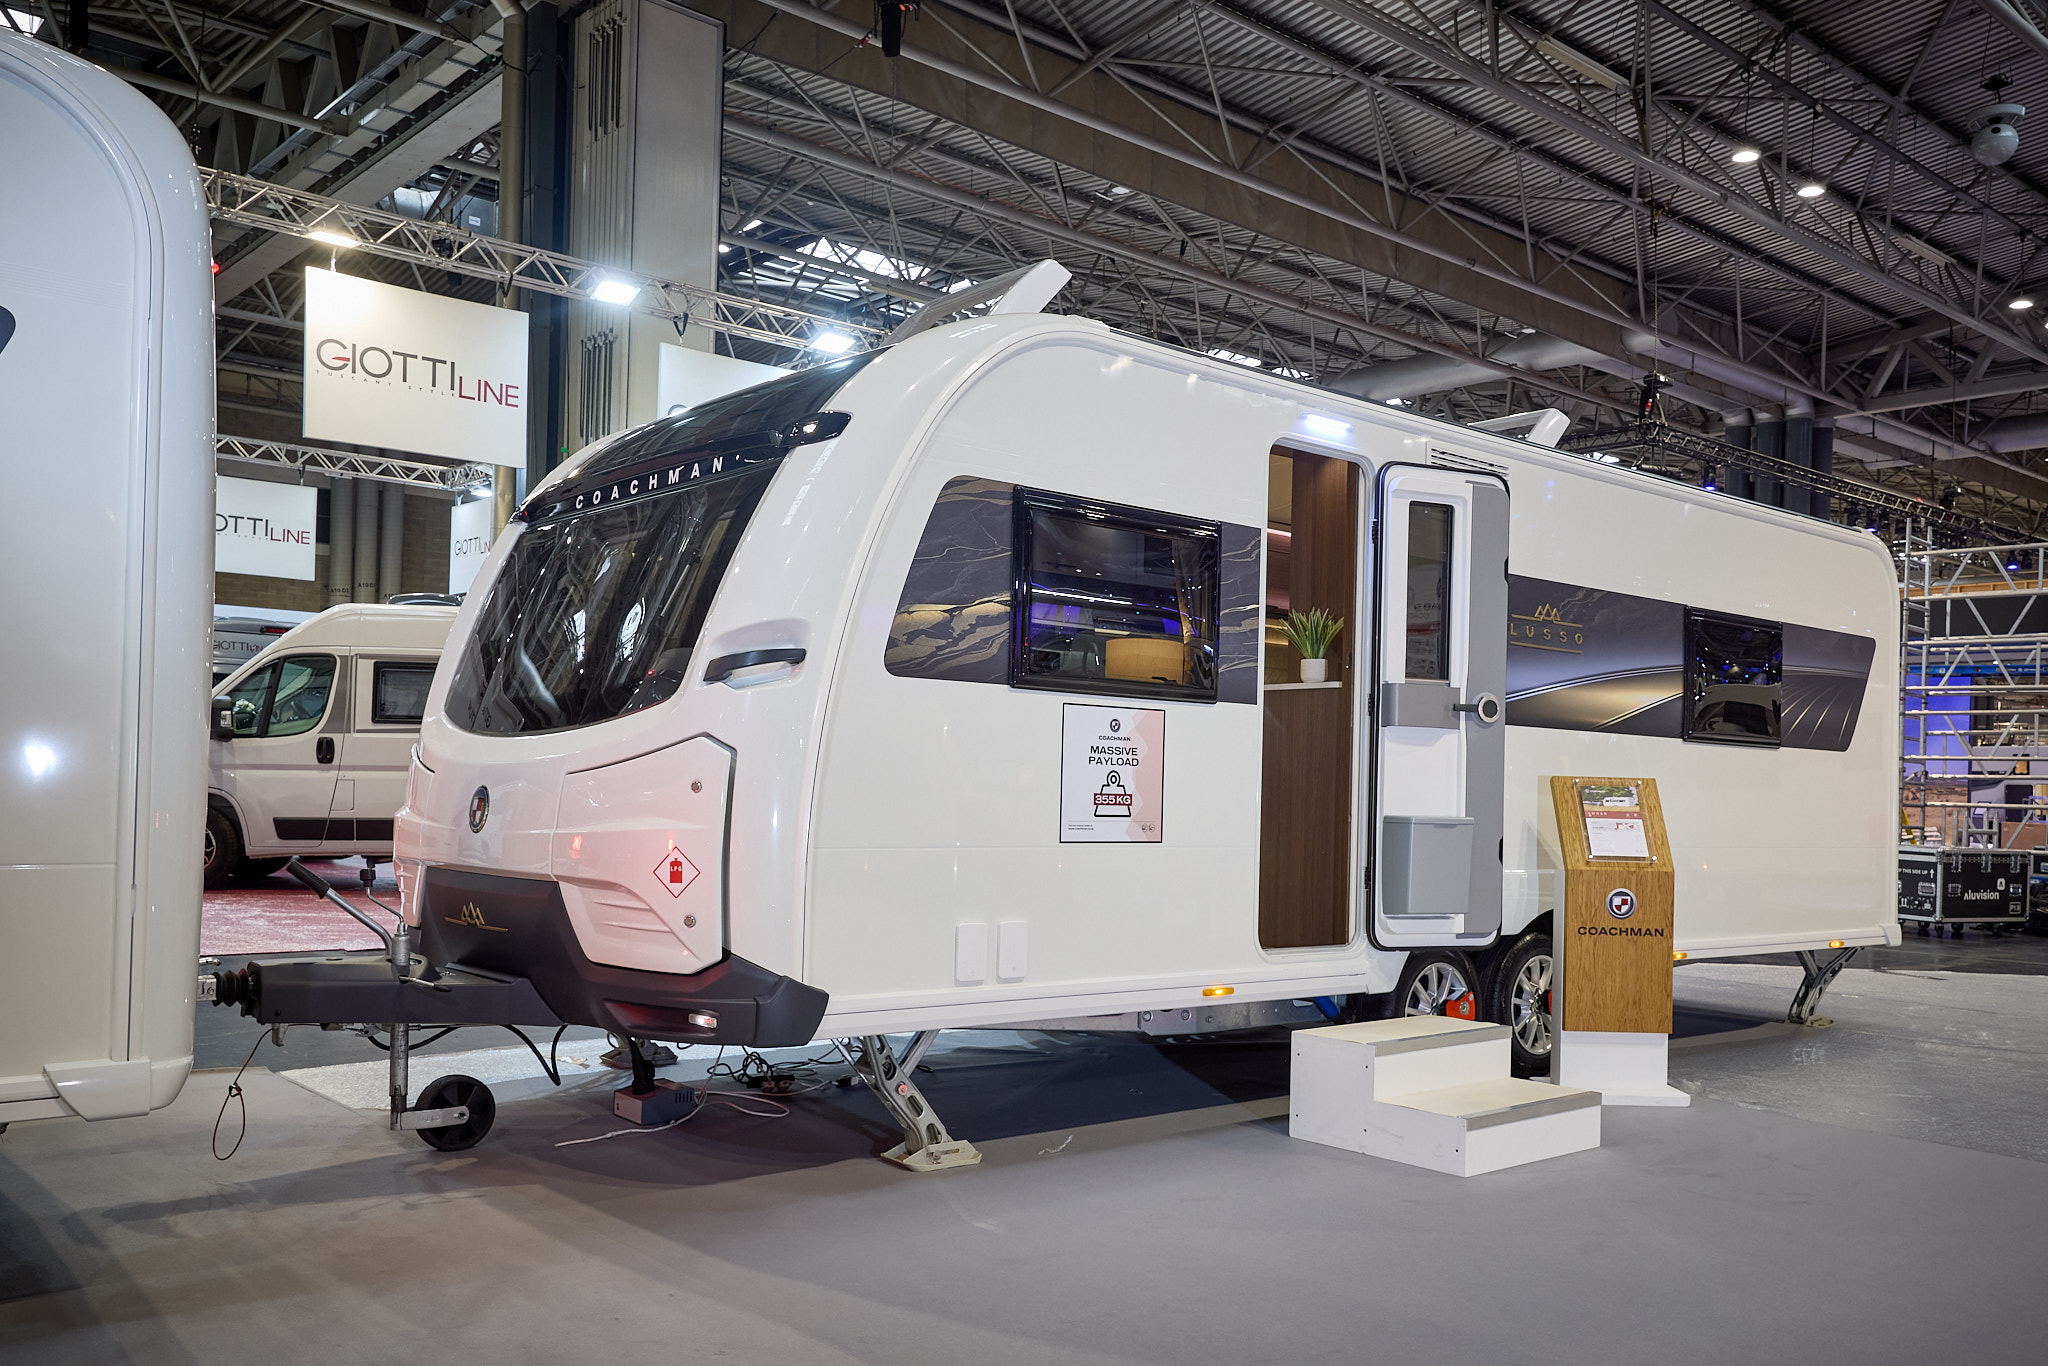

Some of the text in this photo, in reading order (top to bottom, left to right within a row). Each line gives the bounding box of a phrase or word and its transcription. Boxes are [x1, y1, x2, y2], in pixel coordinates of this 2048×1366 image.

[316, 369, 455, 397] TUSCANY STYLE
[575, 456, 723, 509] COACHMAN
[216, 513, 310, 545] OTTILINE
[1510, 623, 1584, 645] LUSSO
[1088, 756, 1139, 767] PAYLOAD
[1090, 745, 1138, 756] MASSIVE
[1577, 926, 1664, 937] COACHMAN
